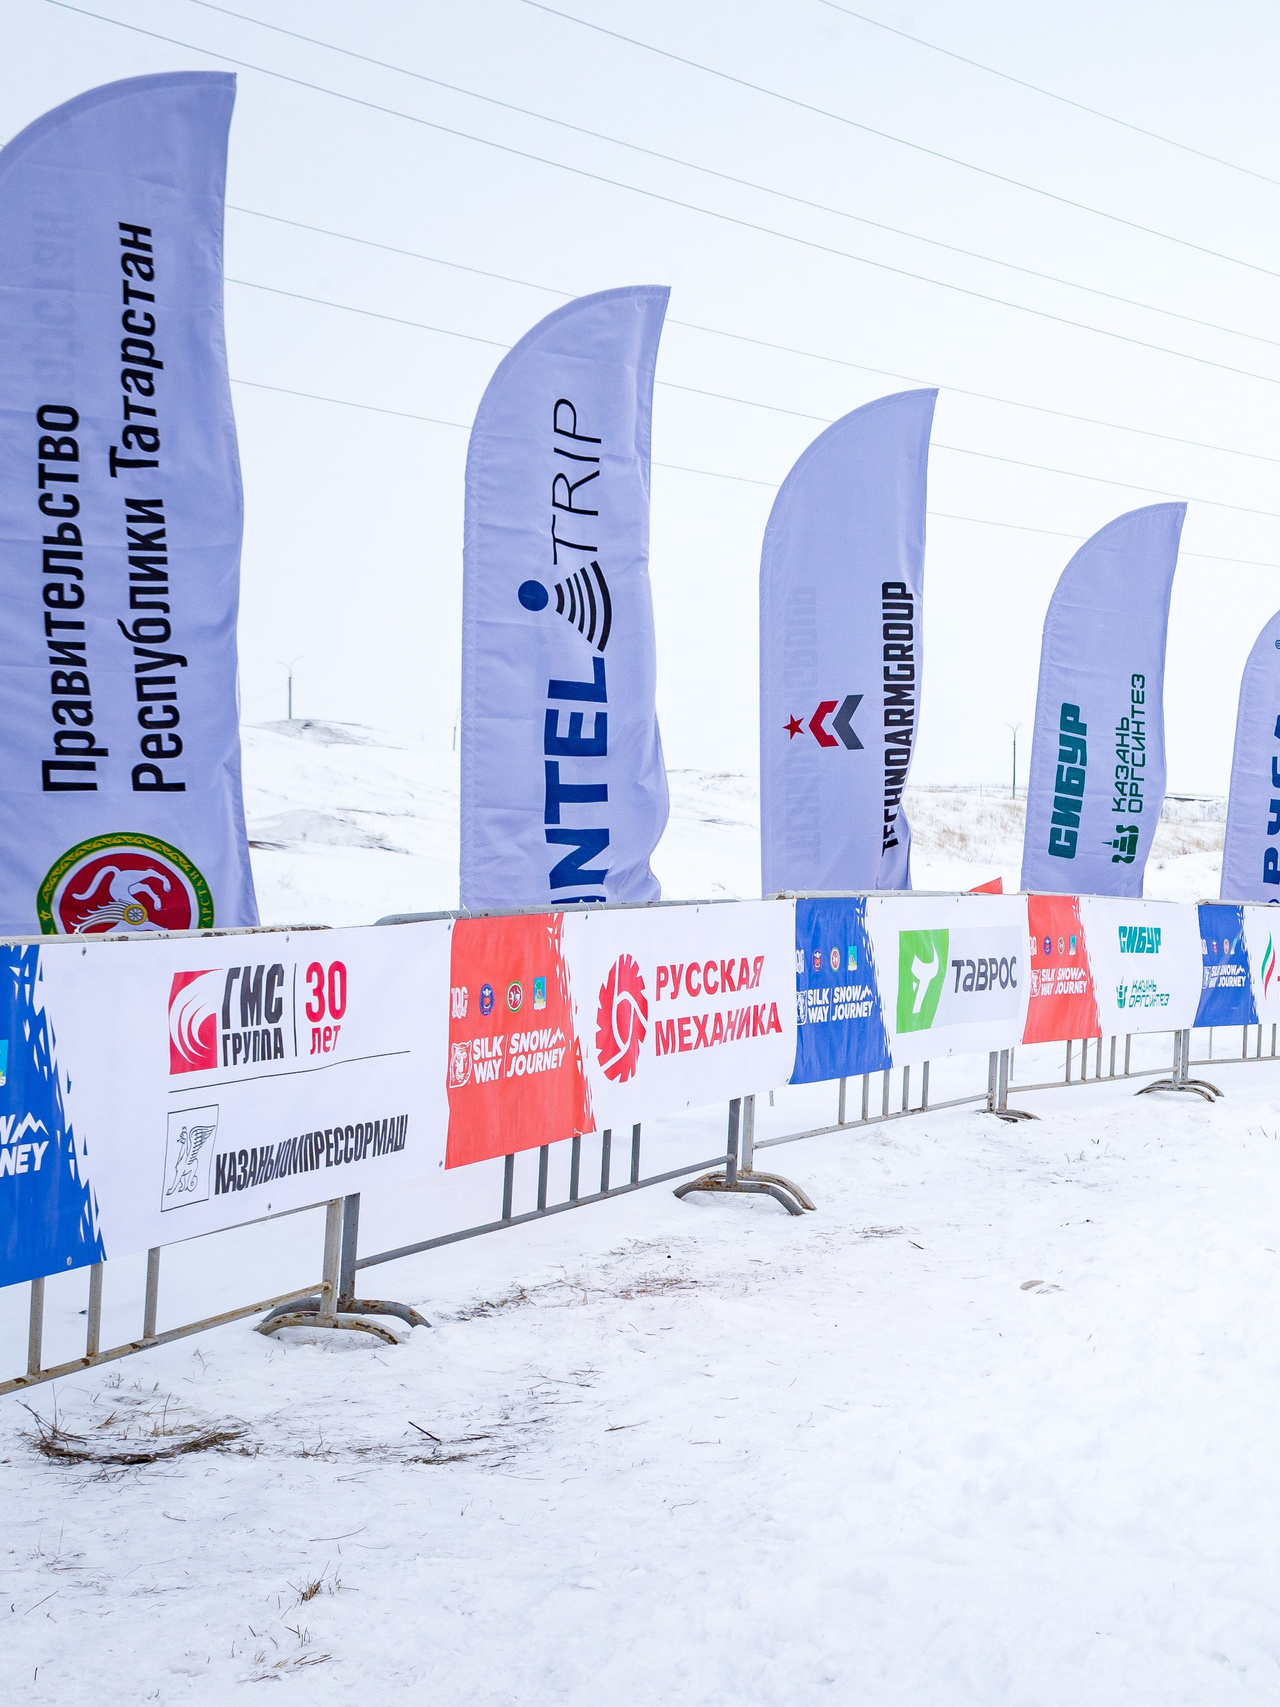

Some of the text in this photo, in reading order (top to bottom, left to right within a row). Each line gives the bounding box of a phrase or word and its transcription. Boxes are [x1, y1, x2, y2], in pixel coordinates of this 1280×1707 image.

[109, 221, 187, 794] Республики Татарстан
[551, 398, 602, 566] TRIP
[36, 403, 109, 794] Правительство
[881, 581, 914, 857] TECHNOARMGROUP
[1128, 673, 1145, 814] ОРГСИНТЕЗ
[1048, 702, 1087, 860] СИБУР
[1111, 716, 1130, 812] КАЗАНЬ
[1118, 926, 1162, 953] СИБУР
[222, 963, 285, 1030] ГМС
[305, 960, 347, 1023] 30
[655, 955, 765, 1002] РУССКАЯ
[808, 985, 862, 1006] SILK SNOW
[1041, 967, 1079, 982] SILK SNOW
[1054, 981, 1087, 995] JOURNEY
[1218, 976, 1246, 987] JOURNEY
[655, 1002, 783, 1056] МЕХАНИКА
[808, 1000, 873, 1023] WAY JOURNEY
[222, 1027, 285, 1067] ГРУППА
[473, 1028, 552, 1061] SILK SNOW
[473, 1047, 566, 1084] WAY JOURNEY
[214, 1114, 409, 1196] КАЗАНЬКОМПРЕССОРМАШ
